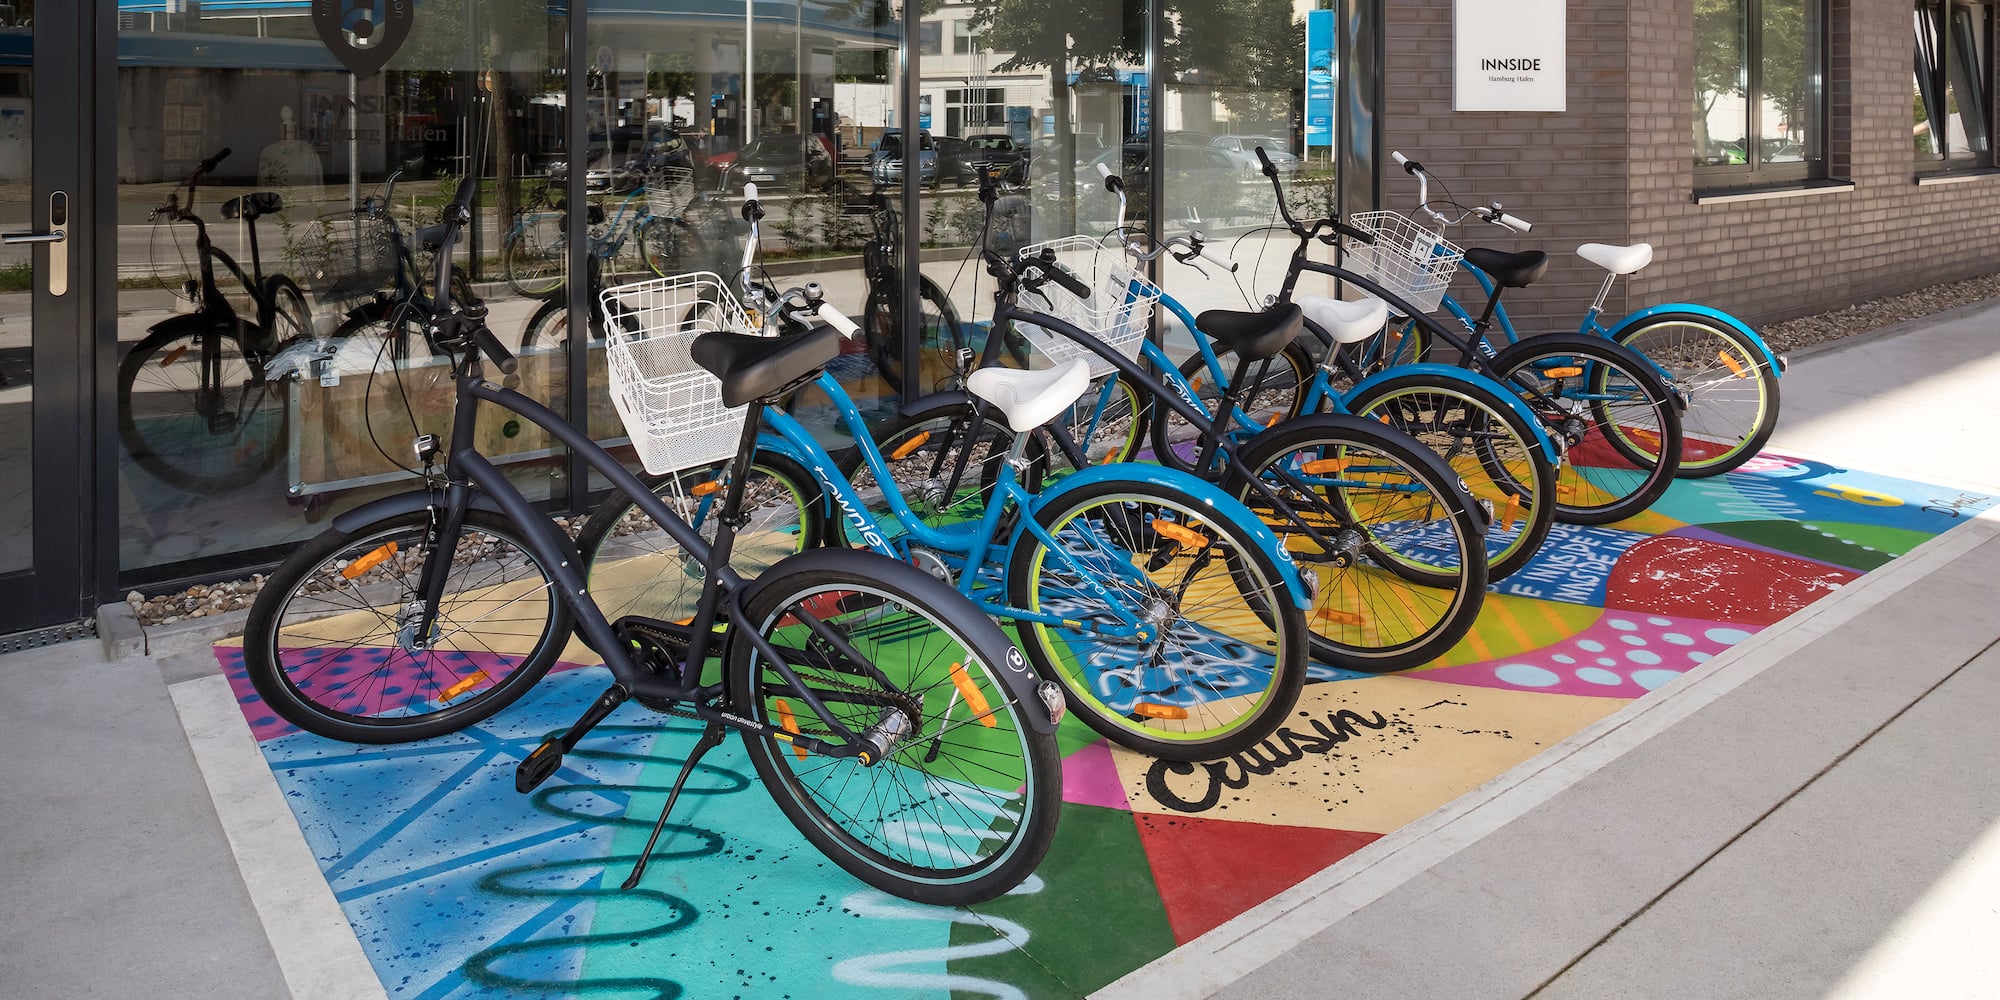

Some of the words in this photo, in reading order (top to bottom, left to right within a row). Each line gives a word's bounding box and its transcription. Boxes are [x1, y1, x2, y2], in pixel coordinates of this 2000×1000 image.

[1481, 58, 1541, 71] INNSIDE
[1488, 75, 1516, 83] Hamburg
[309, 94, 420, 115] INNSIDE
[390, 122, 448, 142] Hafen
[813, 465, 894, 559] townie
[1521, 535, 1602, 583] INNSIDE
[1550, 550, 1618, 604] INNSIDE
[721, 711, 738, 721] urban
